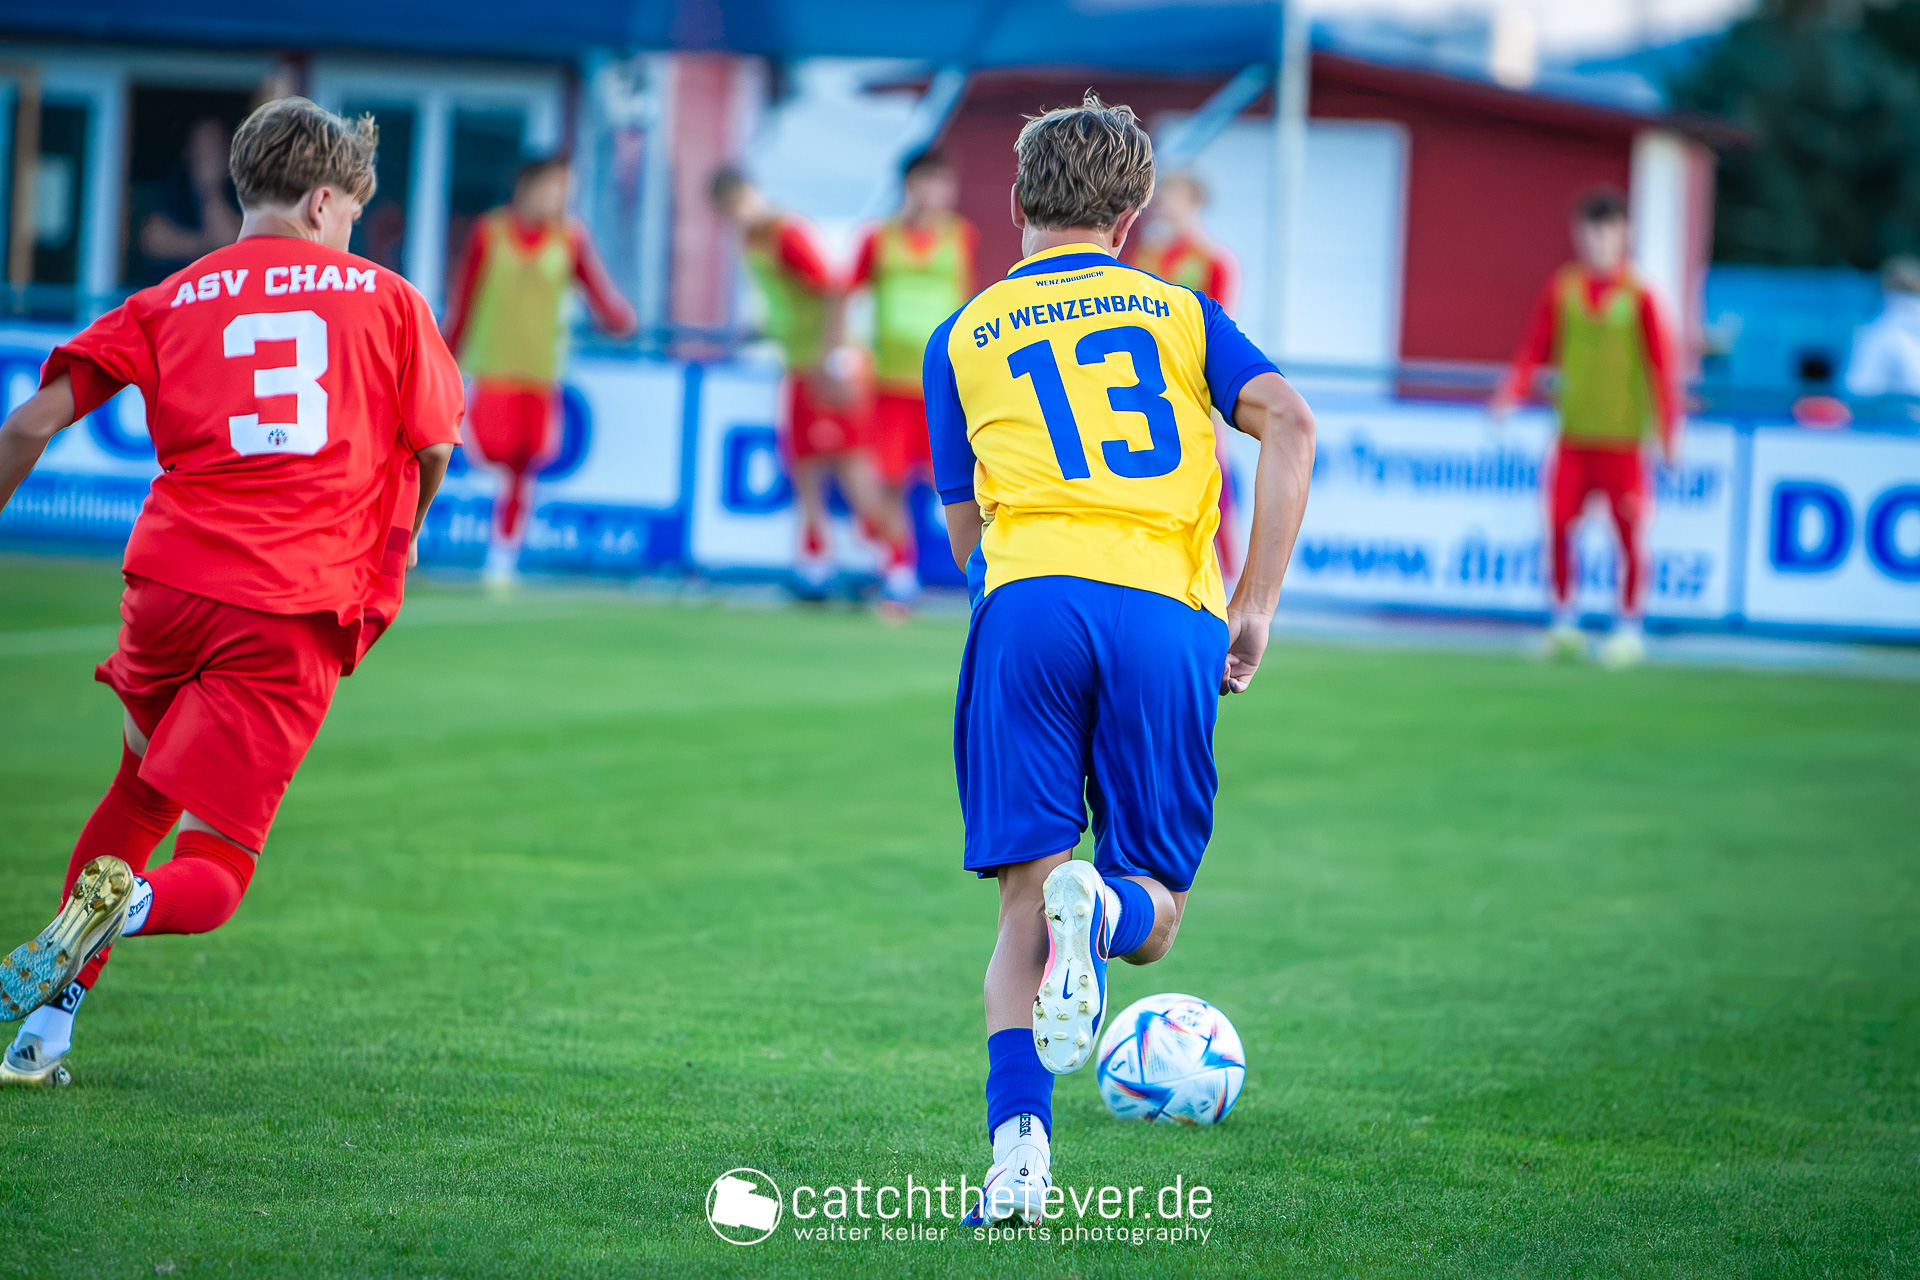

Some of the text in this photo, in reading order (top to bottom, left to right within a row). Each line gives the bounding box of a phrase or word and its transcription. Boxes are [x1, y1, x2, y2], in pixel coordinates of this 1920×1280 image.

[171, 264, 377, 307] ASV CHAM
[973, 294, 1170, 348] SV WENZENBACH
[223, 310, 328, 456] 3
[1007, 325, 1182, 481] 13
